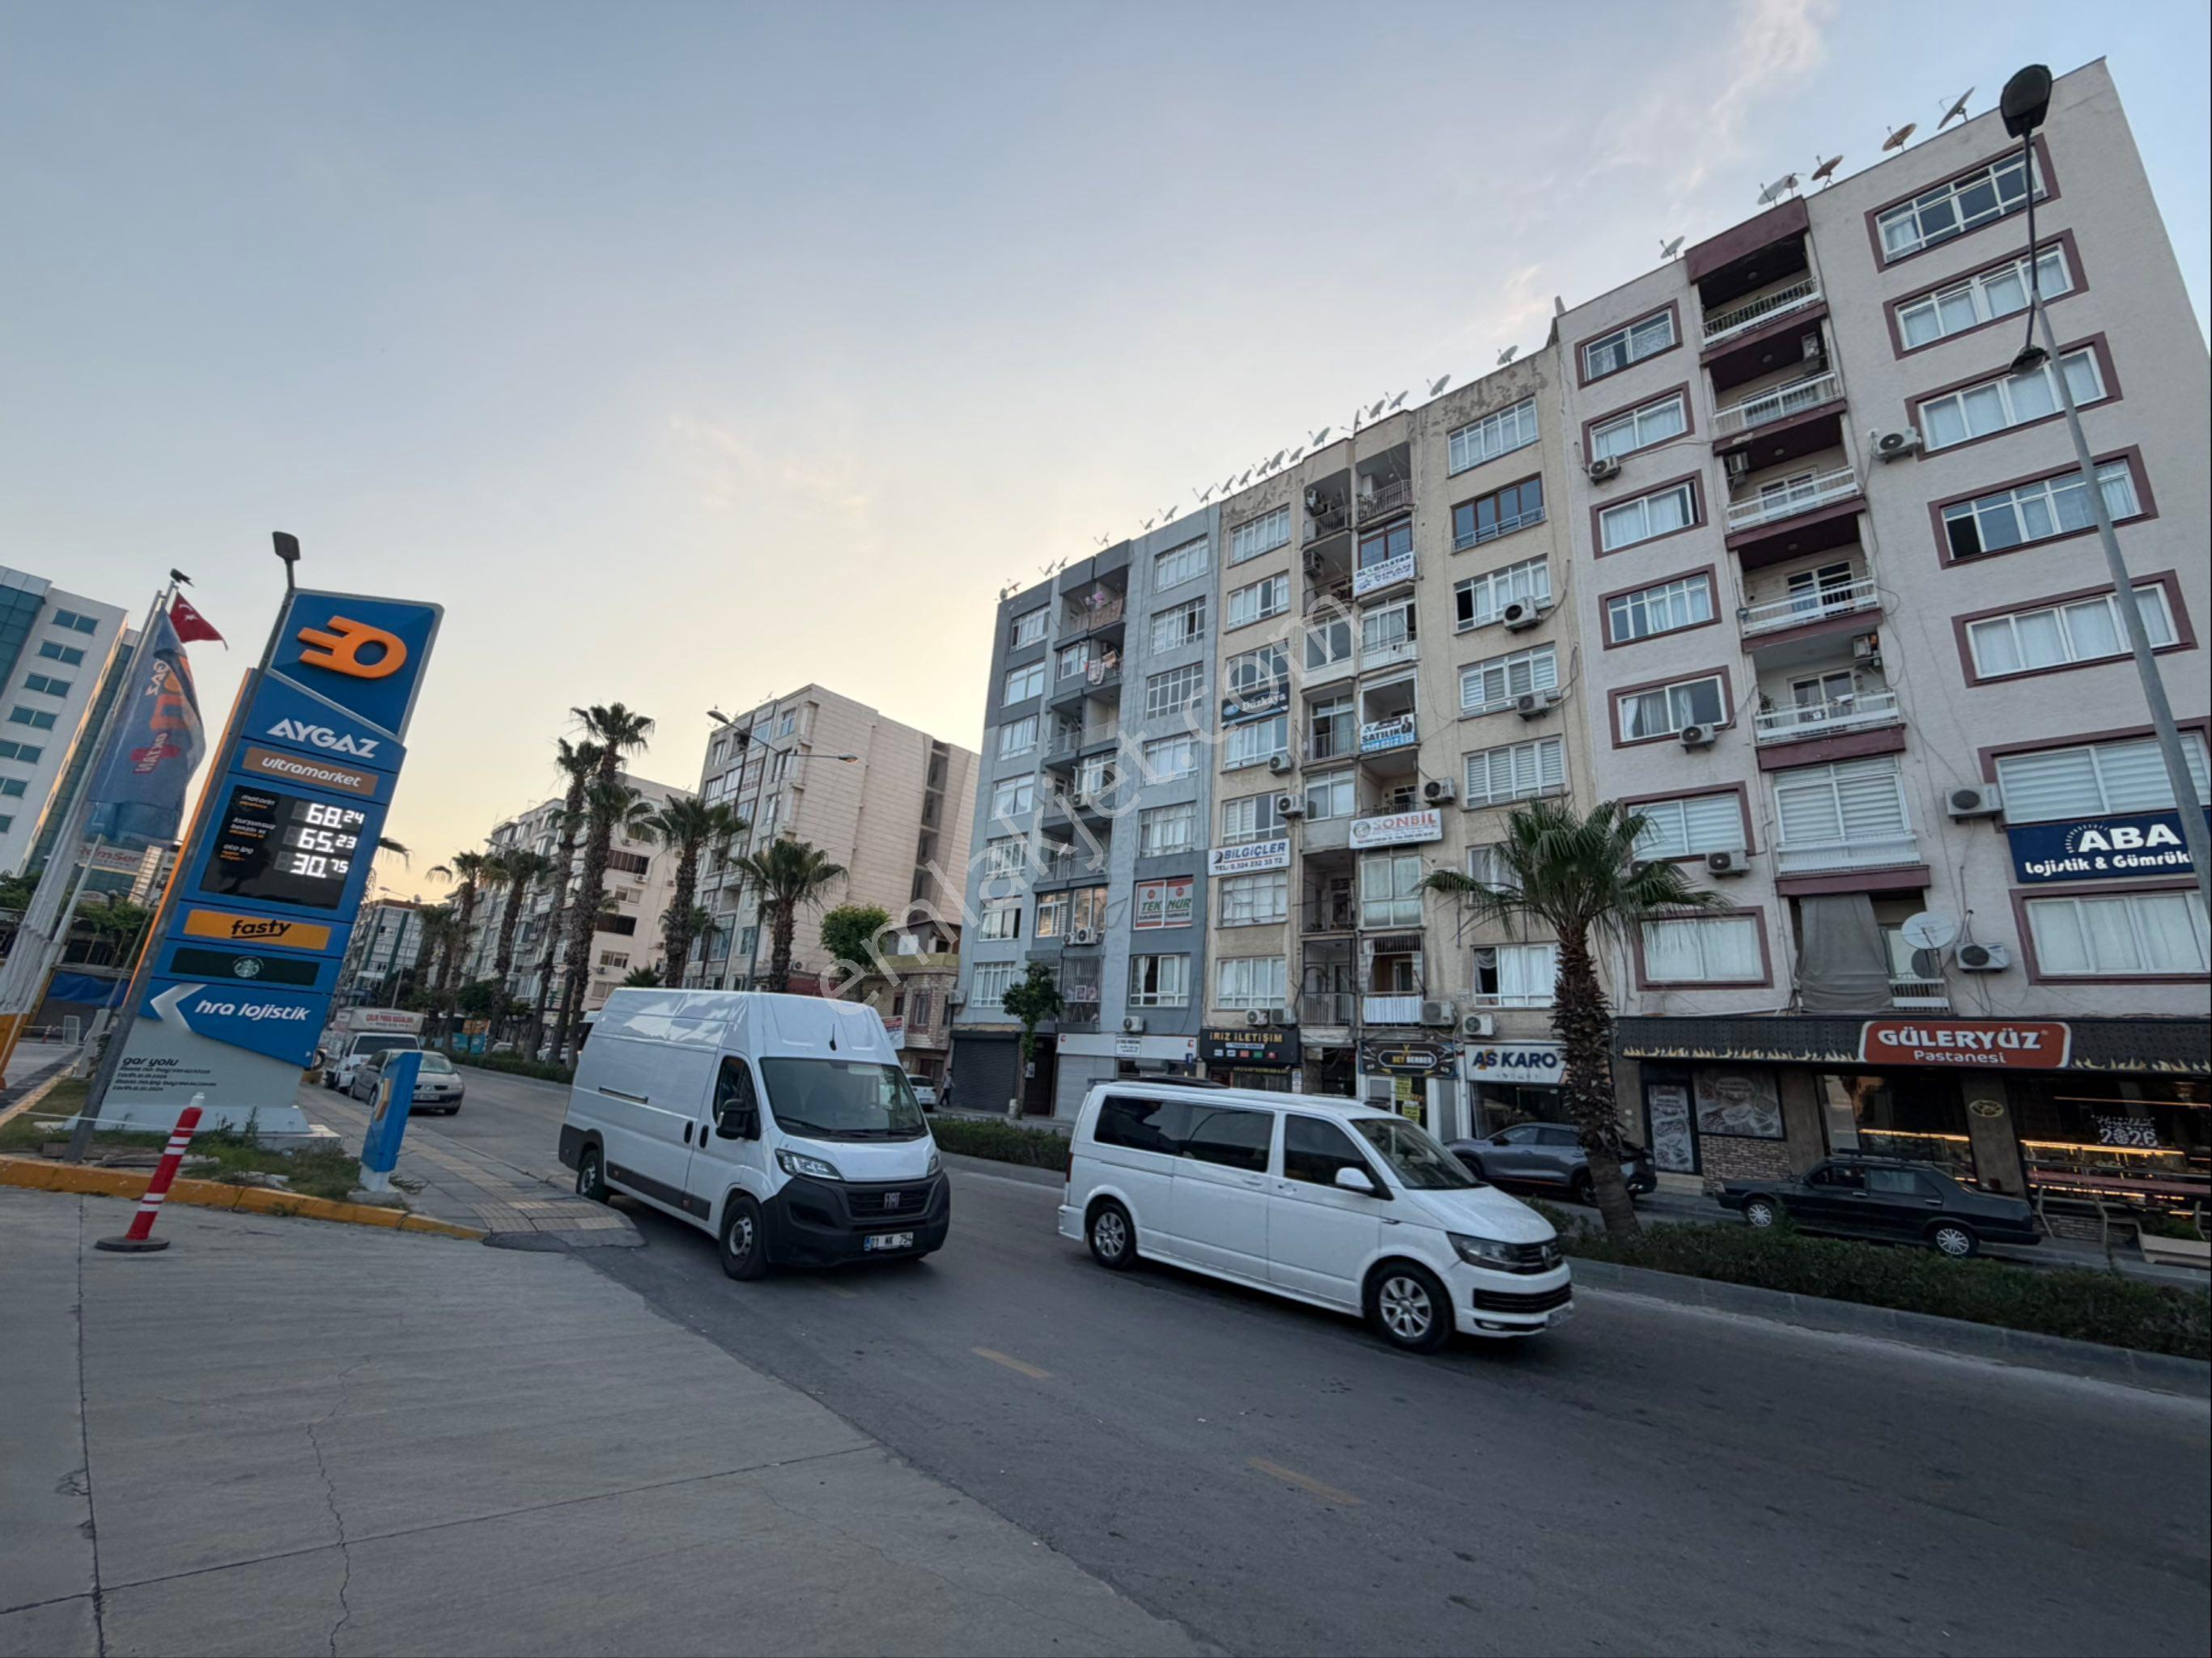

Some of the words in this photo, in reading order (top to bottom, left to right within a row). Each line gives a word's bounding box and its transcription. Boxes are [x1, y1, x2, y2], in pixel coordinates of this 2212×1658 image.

[265, 718, 380, 759] AYGAZ
[1362, 727, 1400, 742] SATILIK
[261, 757, 363, 787] ultramarket
[2078, 824, 2182, 853] ABA
[1225, 842, 1286, 859] BİLGİÇLER
[2095, 856, 2109, 870] &
[231, 919, 291, 938] fasty
[194, 999, 236, 1016] hra
[237, 1003, 312, 1021] lojistik
[1877, 1026, 2042, 1050] GÜLERYÜZ
[148, 1058, 180, 1067] yolu
[1501, 1052, 1558, 1068] KARO
[1914, 1050, 2007, 1064] Pastanesi
